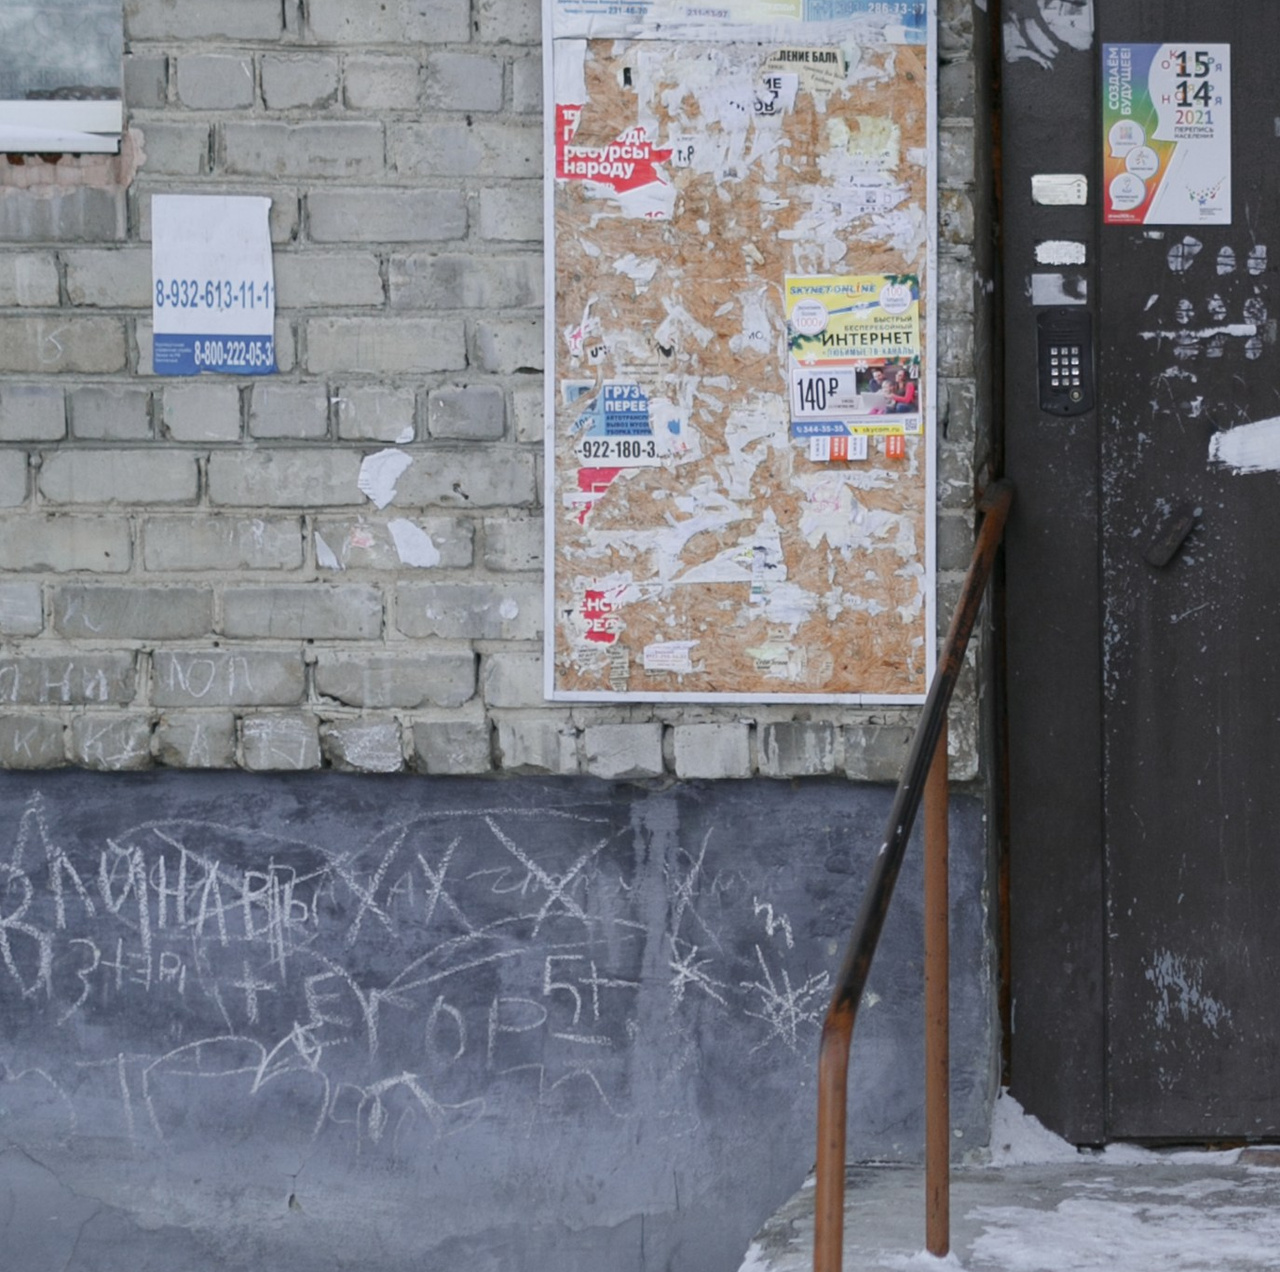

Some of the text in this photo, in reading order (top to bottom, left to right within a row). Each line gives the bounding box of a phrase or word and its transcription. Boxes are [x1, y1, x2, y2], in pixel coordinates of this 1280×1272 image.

[1175, 50, 1210, 79] 15
[1109, 47, 1119, 110] СОЗДАЁМ
[1121, 47, 1132, 115] БУДУЩЕЕ!
[1175, 80, 1212, 107] 14
[1175, 109, 1214, 125] 2021
[564, 162, 635, 179] народу
[156, 279, 274, 309] 8-932-613-11-1
[822, 332, 913, 347] ИНТЕРНЕТ
[604, 386, 647, 399] ГРУЗ
[605, 400, 648, 412] ПЕРЕЕ
[574, 441, 658, 459] -922-180-3
